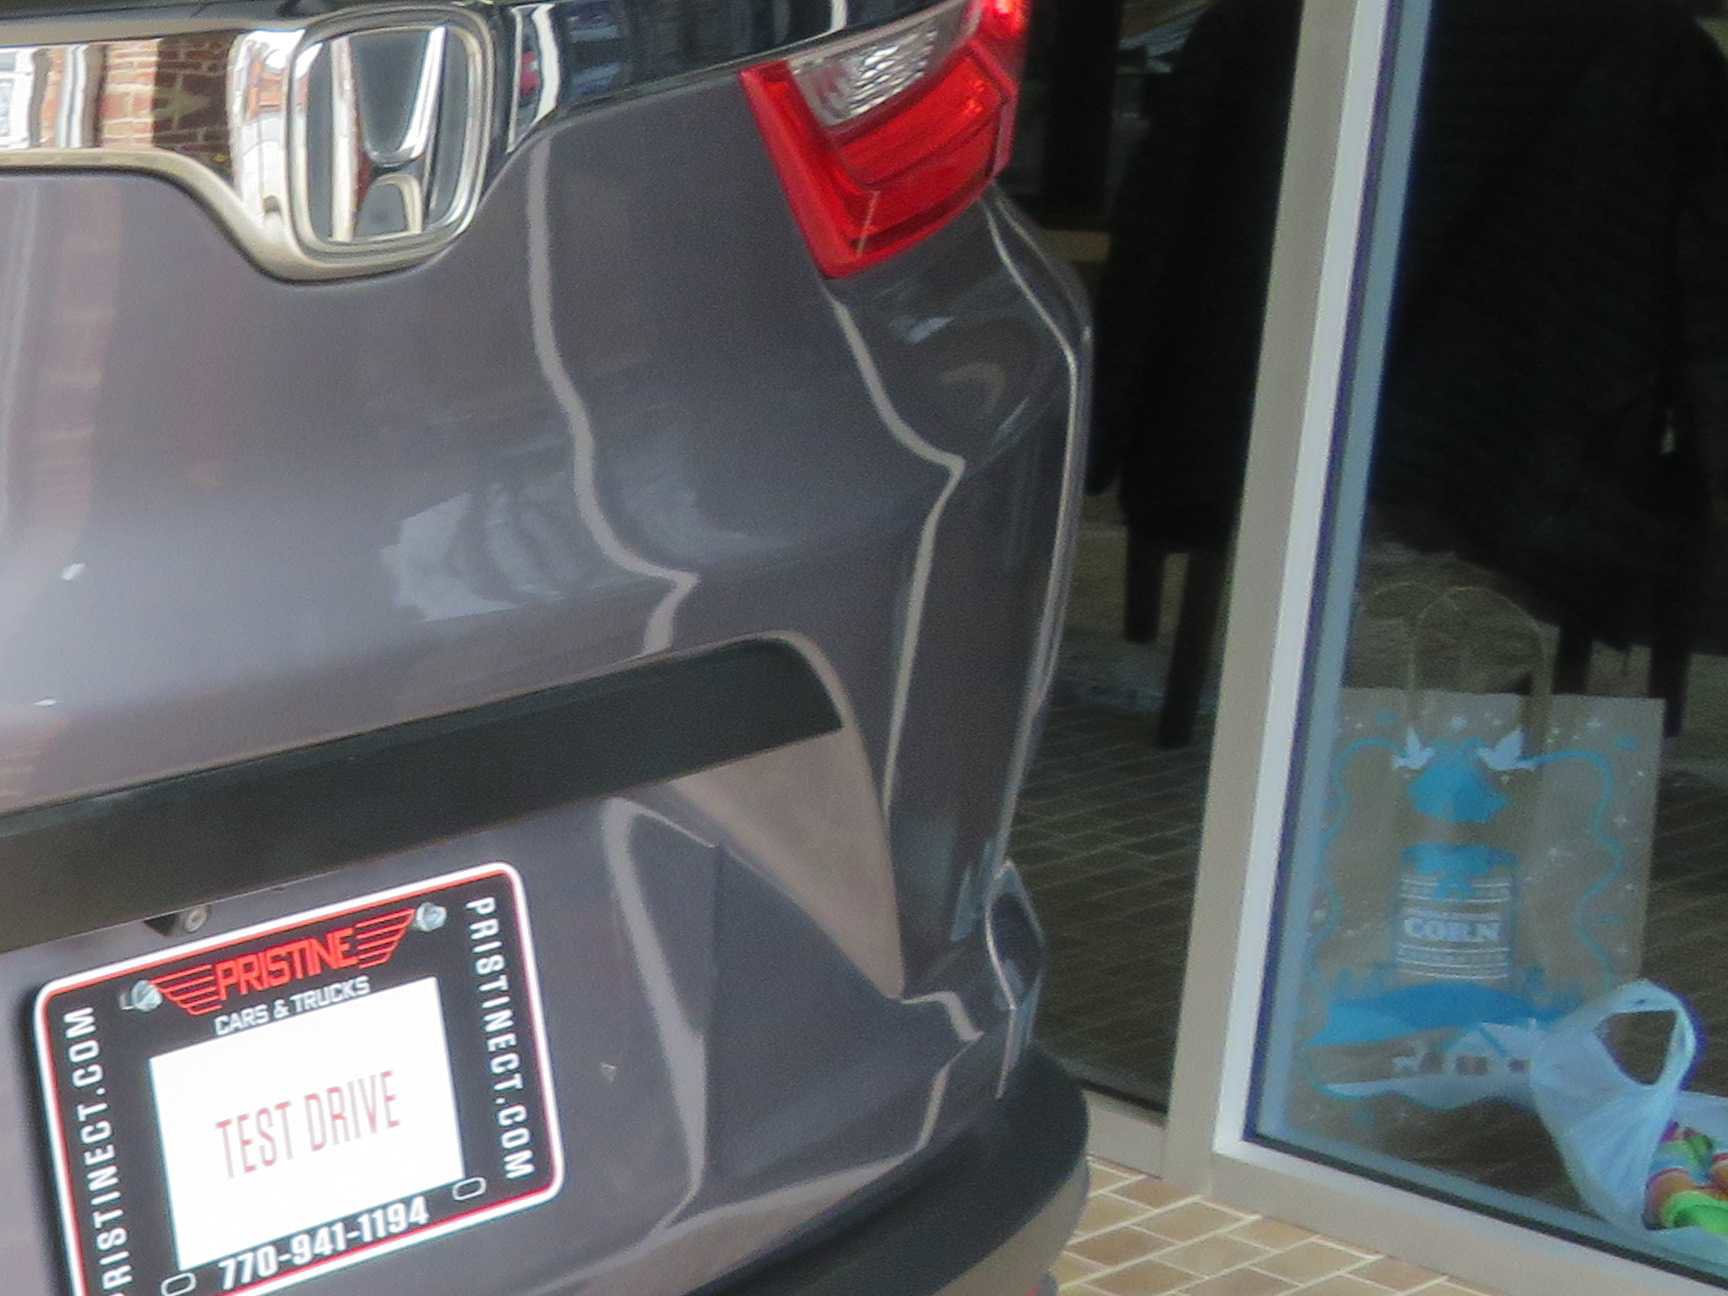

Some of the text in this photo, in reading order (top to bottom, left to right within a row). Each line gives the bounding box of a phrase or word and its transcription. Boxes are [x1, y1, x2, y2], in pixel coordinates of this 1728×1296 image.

[214, 976, 371, 1036] CARS & TRUCKS
[215, 928, 359, 1000] PRISTINE
[465, 896, 535, 1179] PRISTINECT.COM
[215, 1070, 400, 1179] TEST DRIVE
[218, 1195, 430, 1290] 770-941-1194
